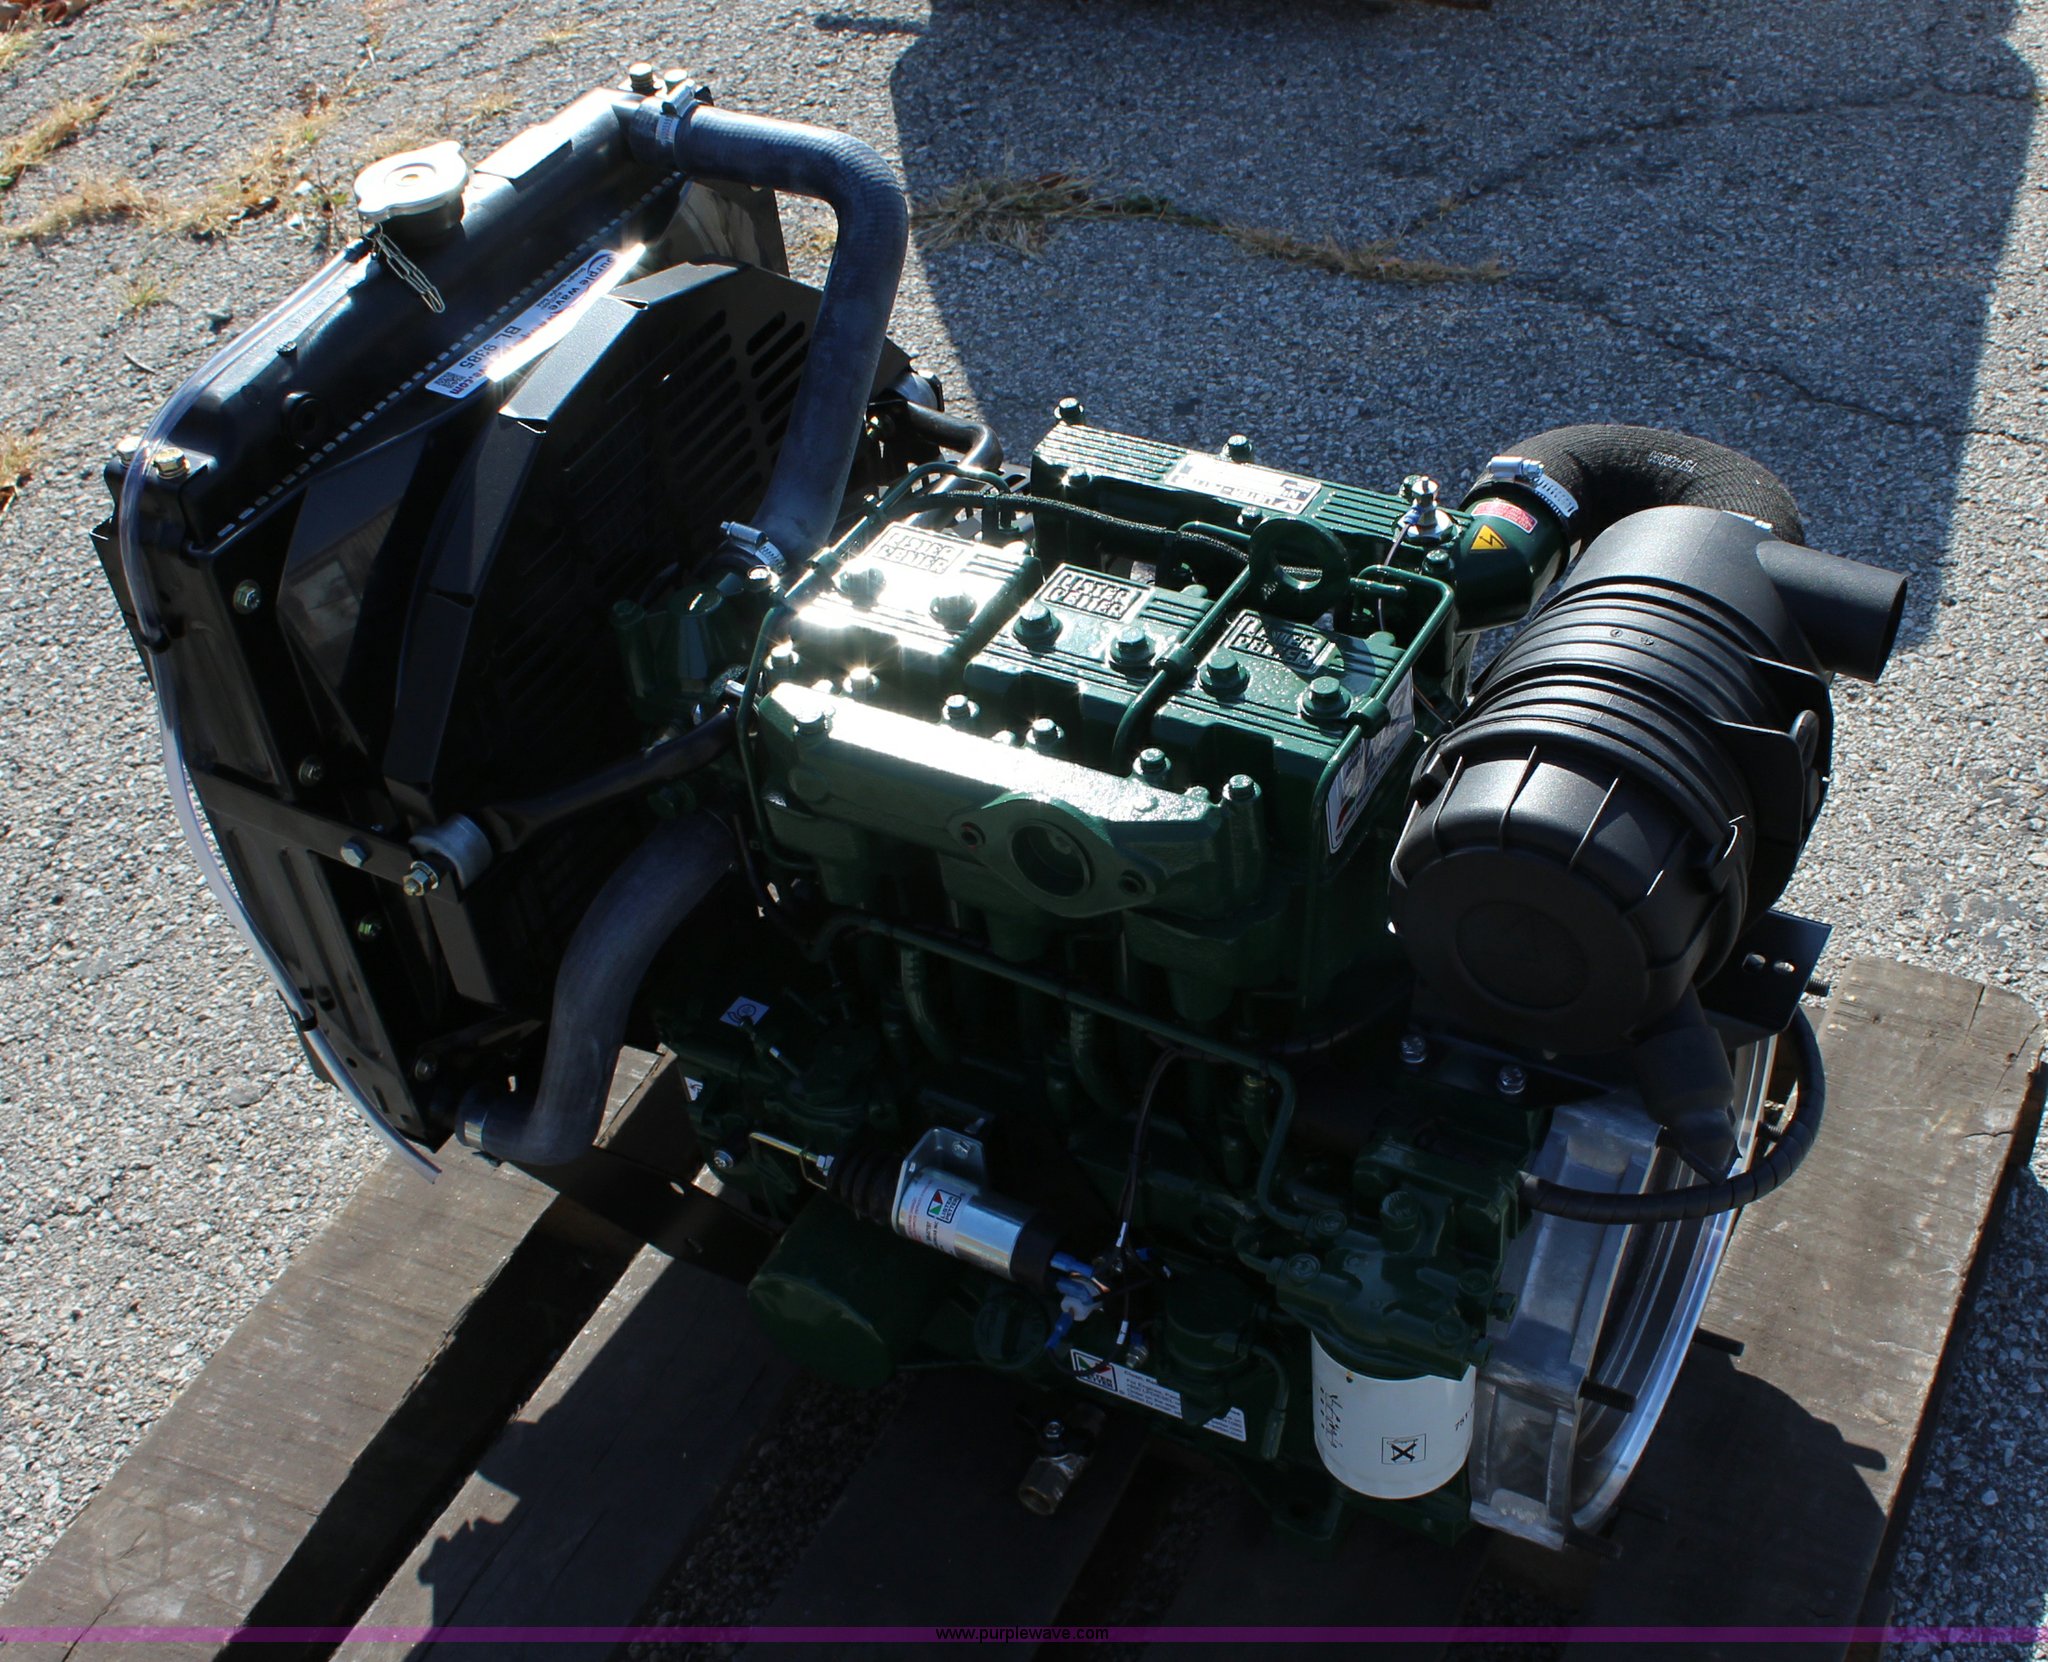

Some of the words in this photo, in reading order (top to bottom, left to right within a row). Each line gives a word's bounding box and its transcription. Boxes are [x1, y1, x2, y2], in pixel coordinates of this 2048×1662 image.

[580, 256, 615, 285] purple
[548, 287, 580, 311] wave
[495, 325, 522, 339] BL
[459, 343, 497, 369] 9385
[877, 544, 949, 573] PETTER
[887, 532, 956, 558] LISTER
[1058, 572, 1132, 605] LISTER
[1048, 587, 1125, 619] PETTER
[1241, 618, 1321, 651] LISTER
[1231, 634, 1314, 666] PETTER
[940, 1196, 955, 1219] LISTER
[944, 1198, 960, 1221] PETTER
